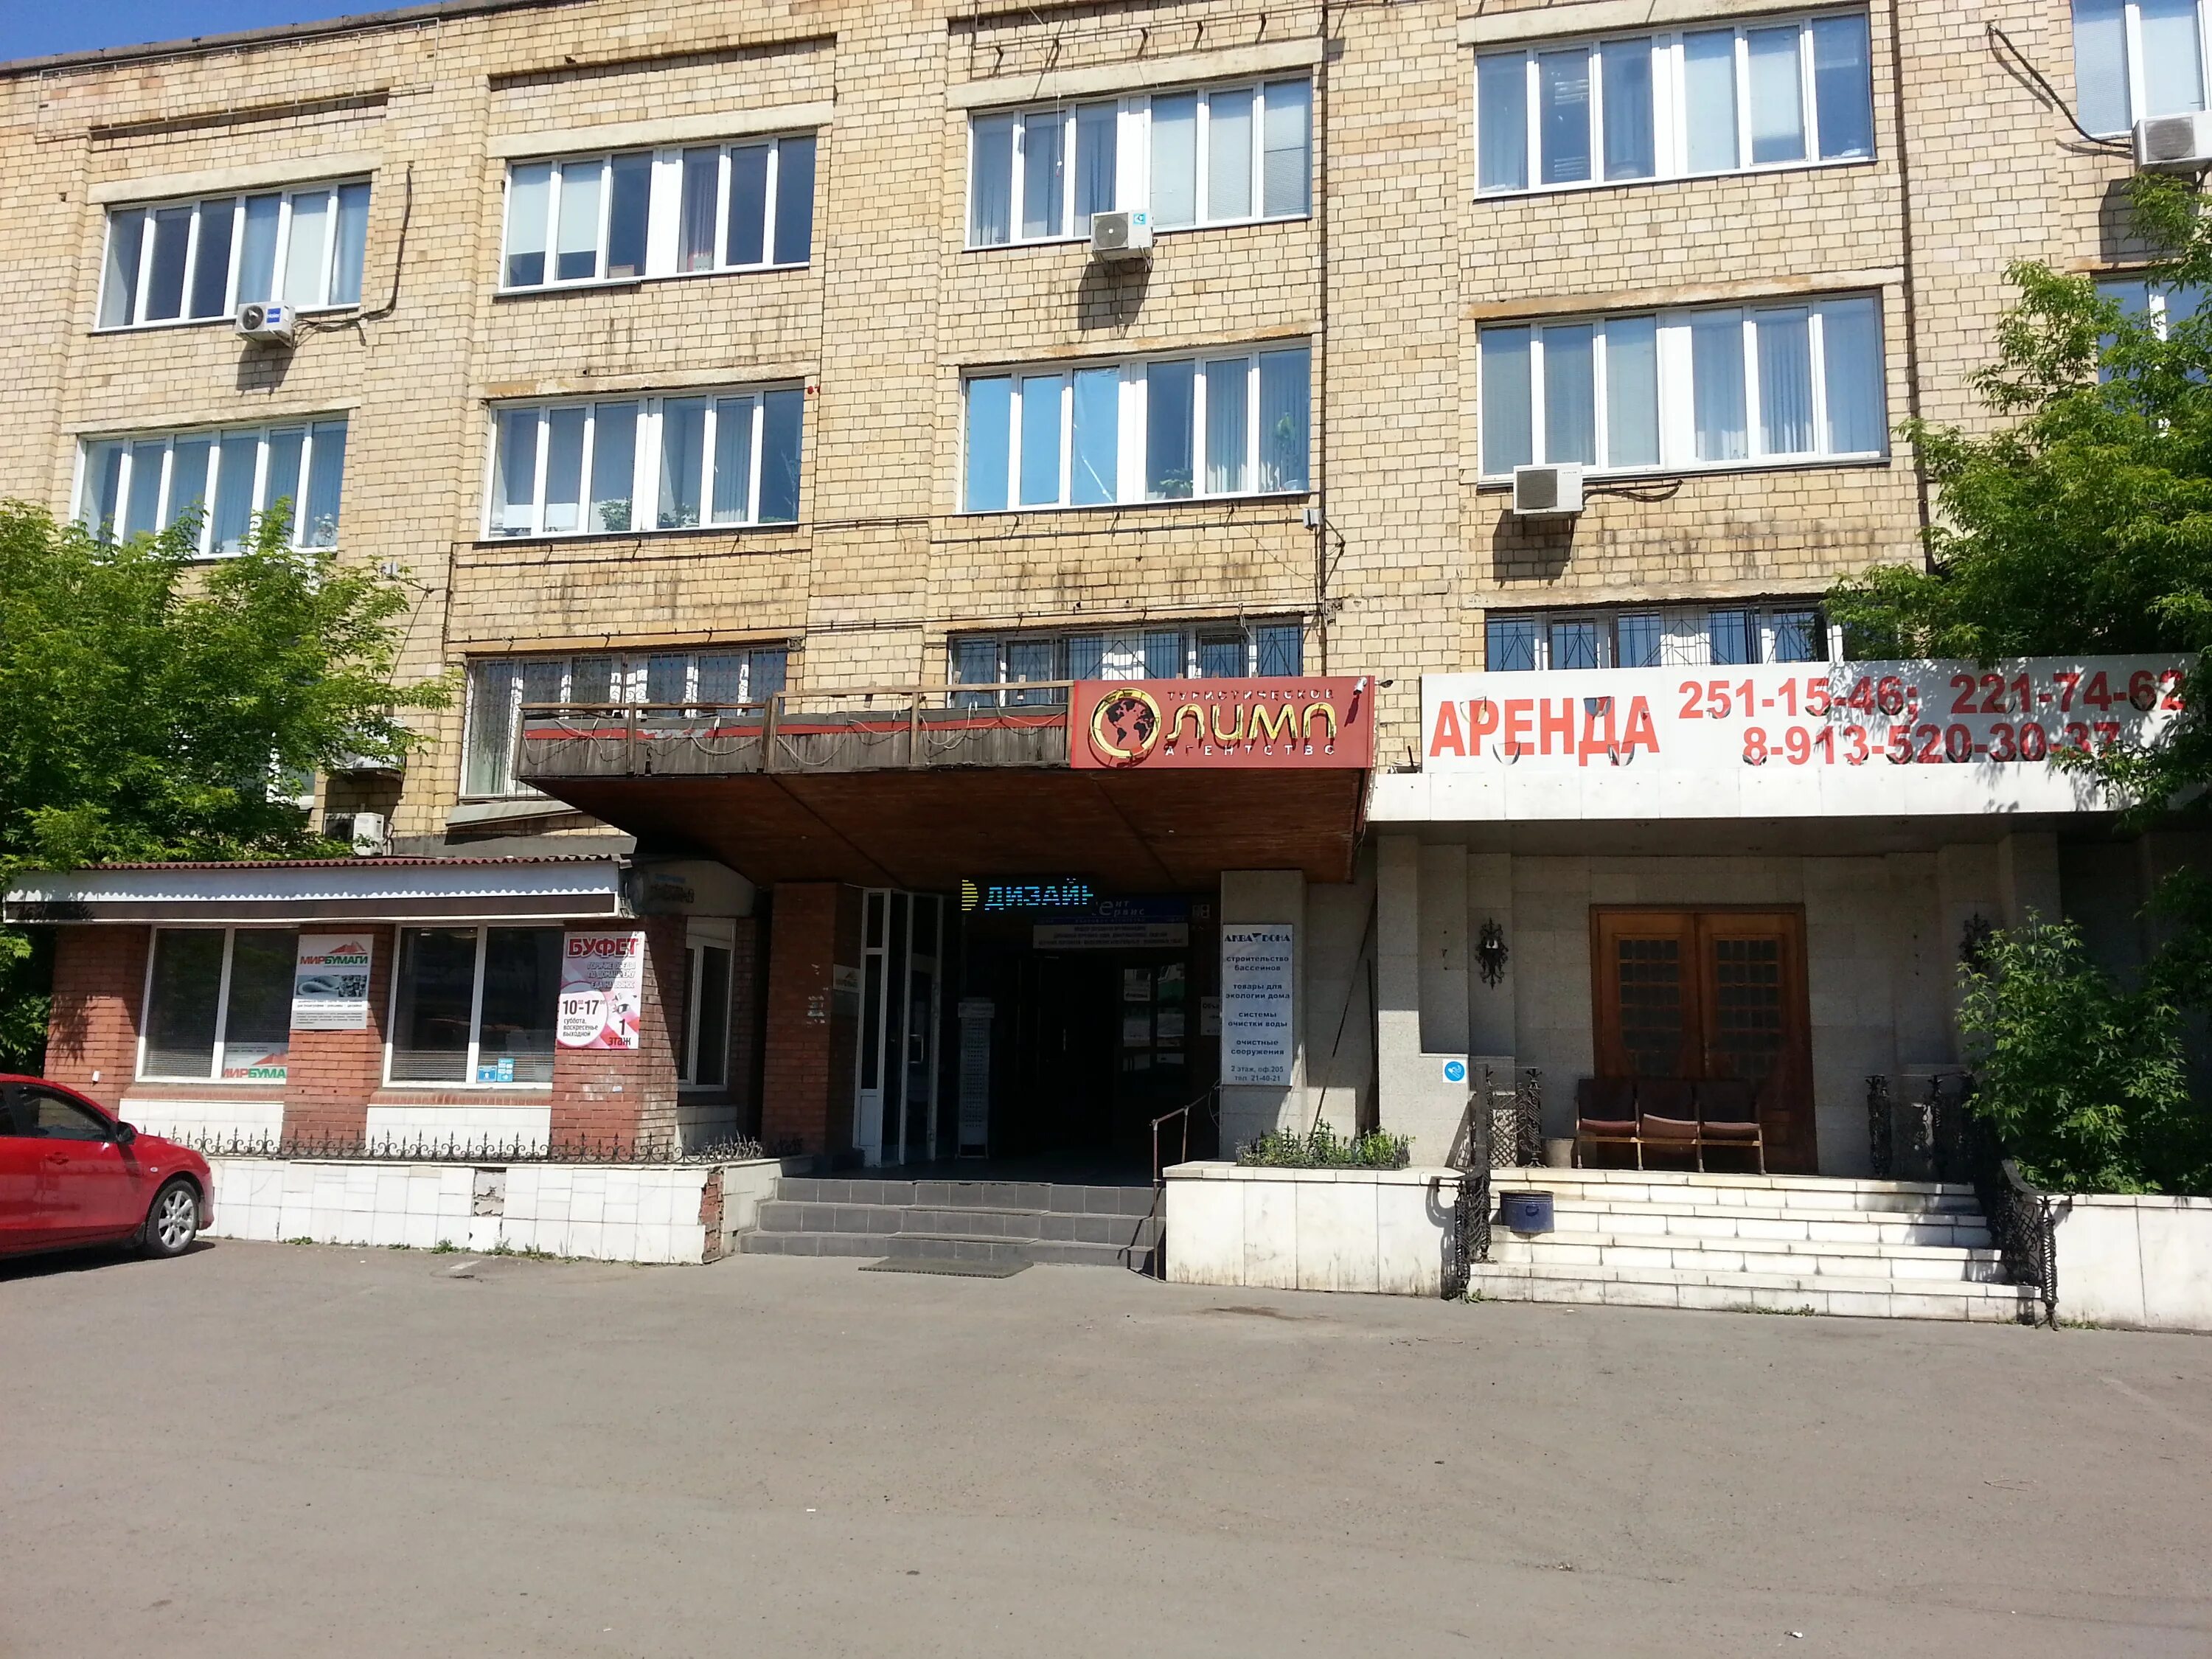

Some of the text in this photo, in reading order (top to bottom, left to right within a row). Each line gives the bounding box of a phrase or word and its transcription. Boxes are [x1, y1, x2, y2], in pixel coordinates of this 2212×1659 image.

[1167, 689, 1334, 700] ТУРИСТИЧЕСКОЕ
[1951, 669, 2185, 714] 221-74-62
[1429, 696, 1660, 766] АРЕНДА
[1165, 745, 1335, 757] АГЕНТСТВО
[1742, 721, 2121, 765] 8-913-520-30-37
[568, 939, 639, 957] БУФЕТ
[300, 956, 368, 964] МИРБУМАГИ
[619, 1018, 625, 1036] 1
[608, 1037, 631, 1046] этаж
